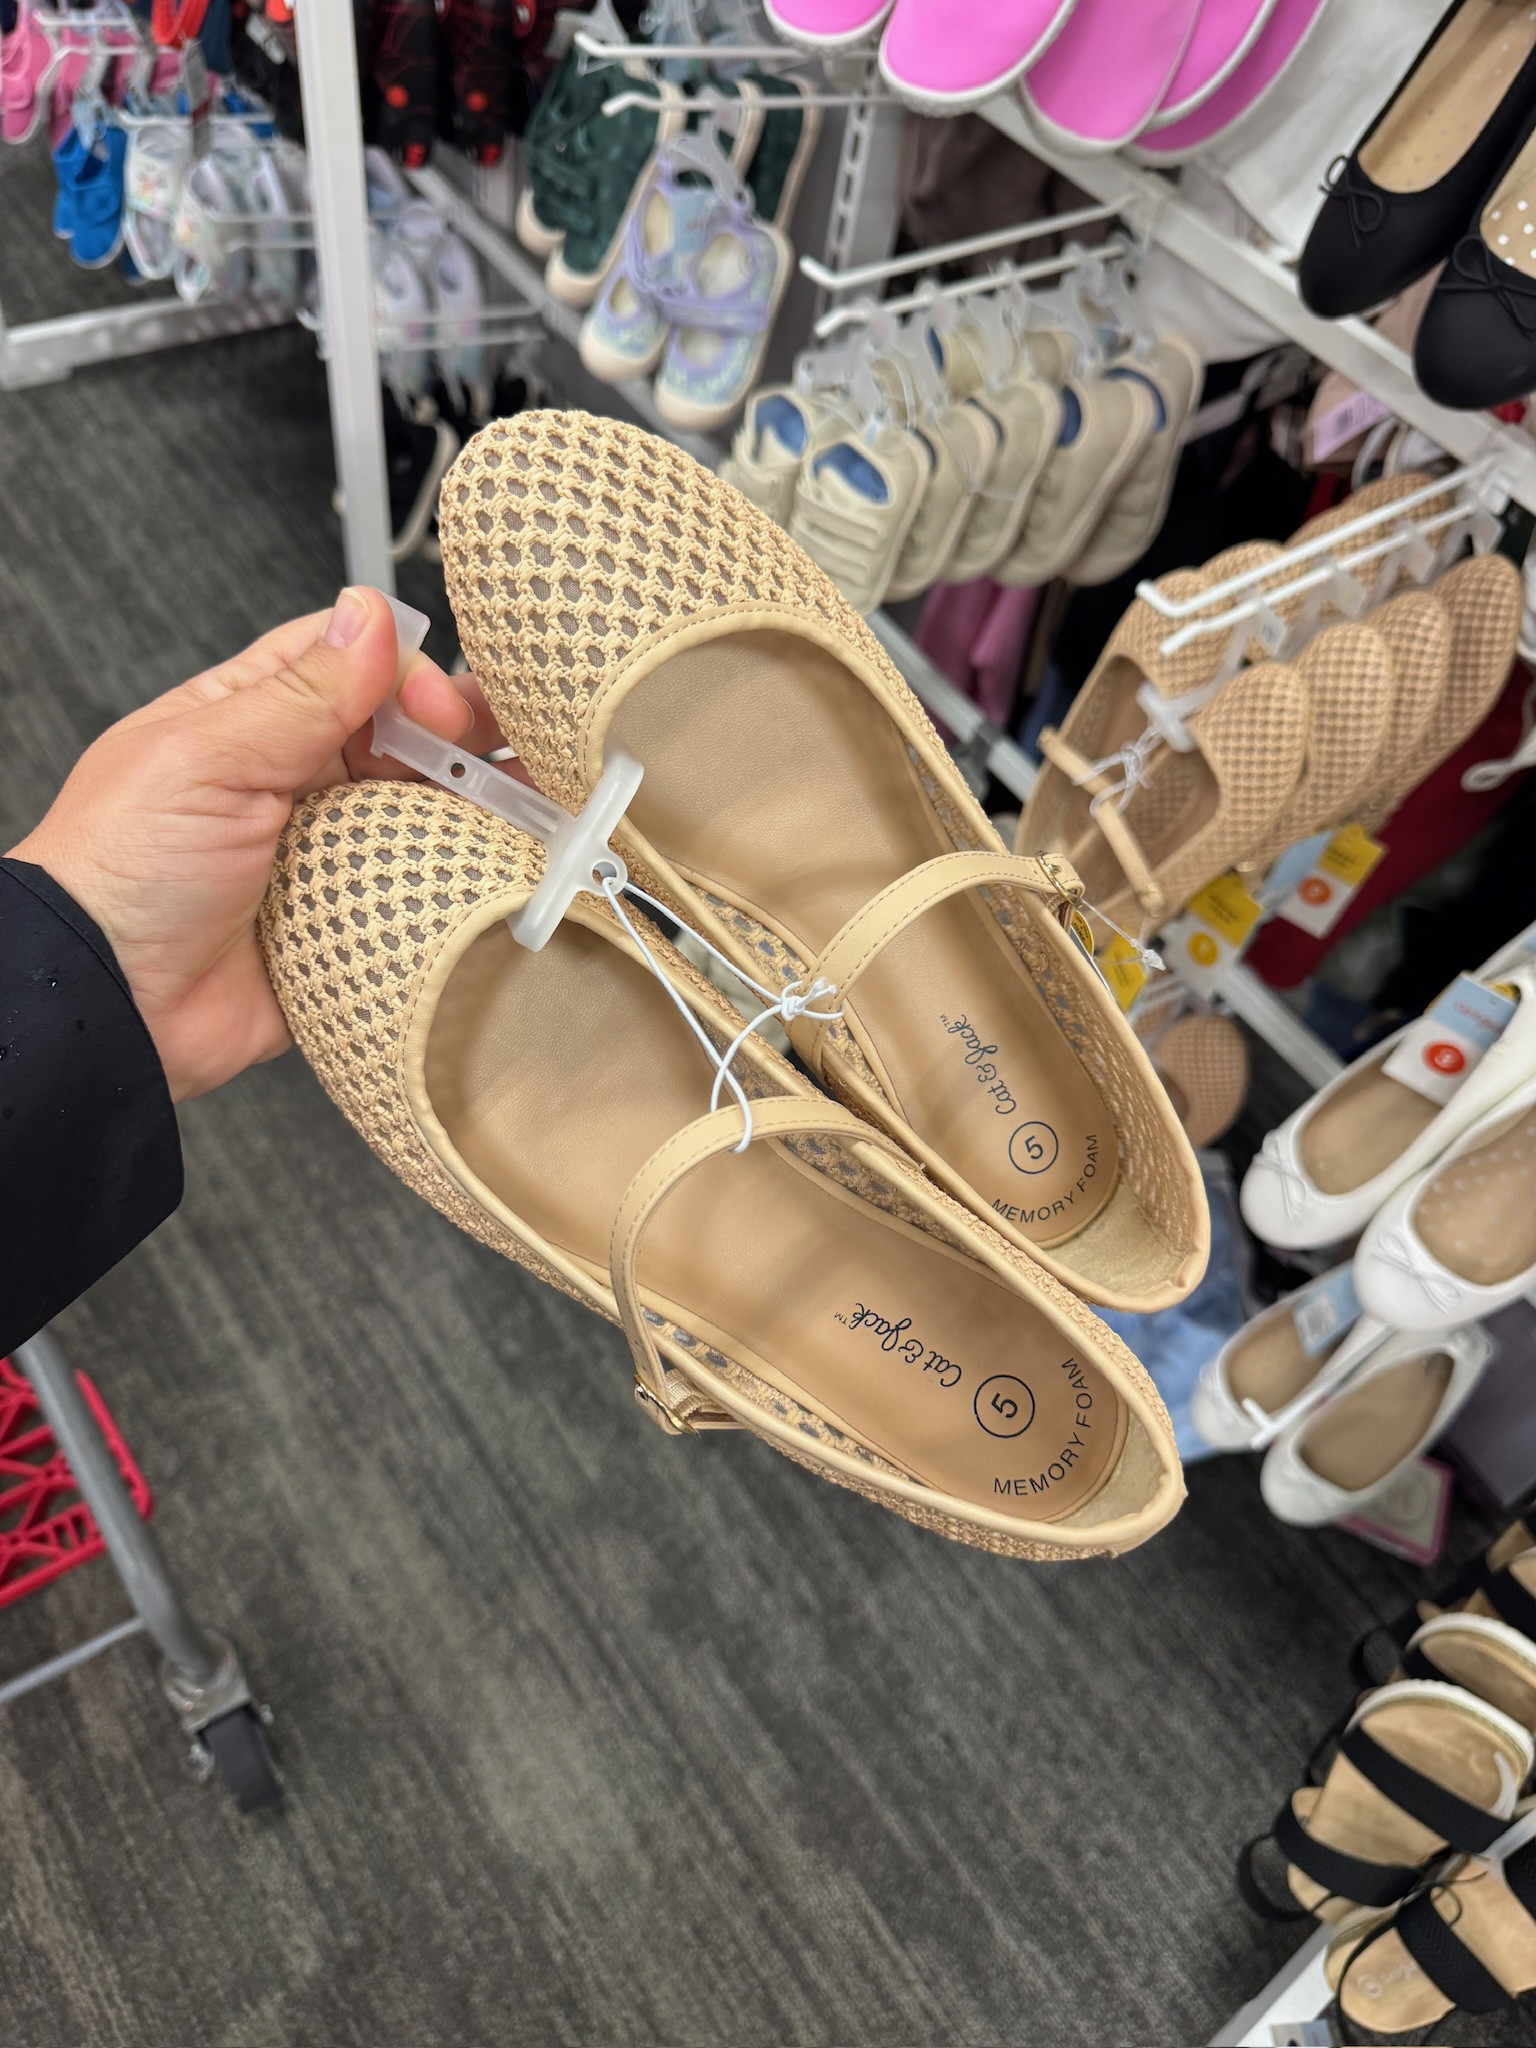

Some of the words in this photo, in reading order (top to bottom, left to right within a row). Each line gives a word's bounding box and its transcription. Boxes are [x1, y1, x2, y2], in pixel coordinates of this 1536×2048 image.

[976, 1063, 997, 1083] &
[987, 1079, 1017, 1115] Cat
[1024, 1135, 1044, 1160] 5
[992, 1191, 1075, 1223] MEMORY
[1076, 1134, 1098, 1192] FOAM
[898, 1338, 924, 1363] &
[922, 1350, 962, 1387] Cat
[991, 1392, 1018, 1418] 5
[993, 1432, 1085, 1496] MEMORY
[1061, 1357, 1093, 1428] FOAM
